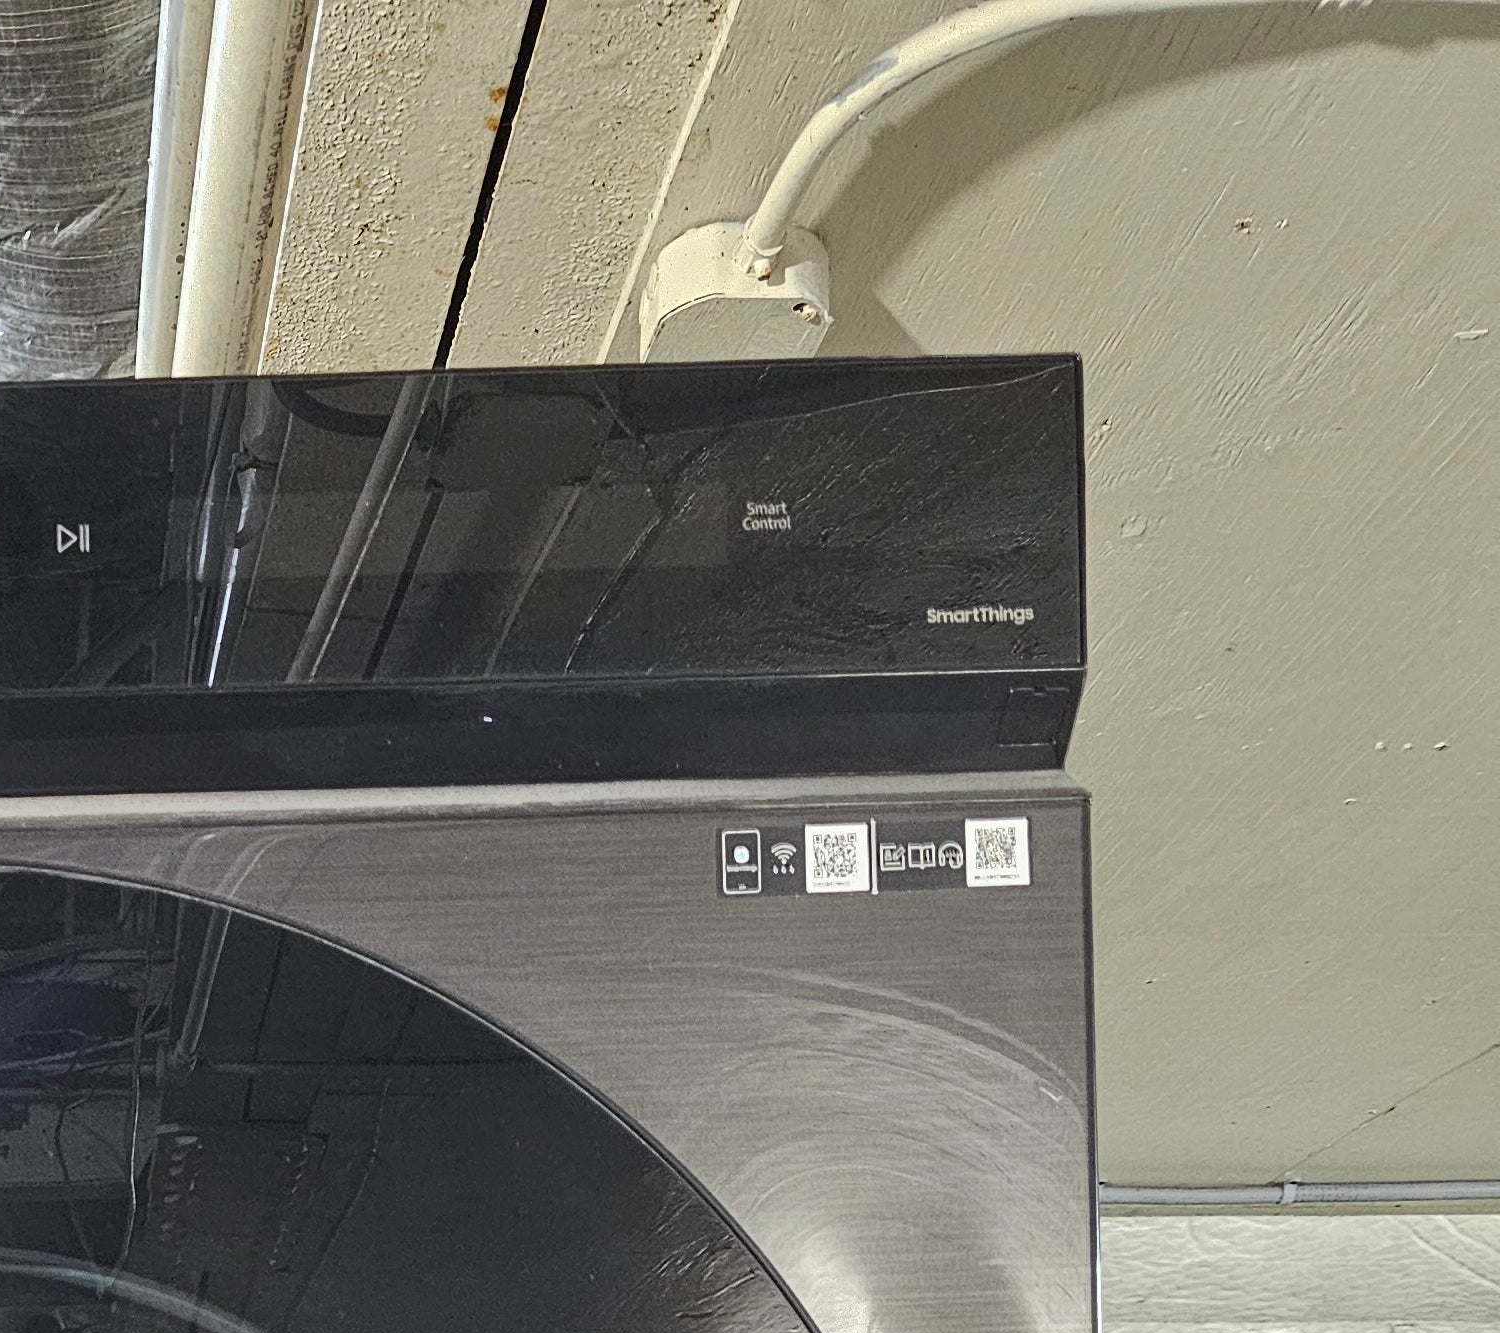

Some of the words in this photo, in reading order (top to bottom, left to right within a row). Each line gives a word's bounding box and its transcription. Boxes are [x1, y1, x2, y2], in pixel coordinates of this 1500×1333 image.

[268, 141, 282, 158] 40
[278, 54, 298, 100] CASING
[746, 501, 787, 516] Smart
[742, 515, 791, 531] Control
[926, 604, 1034, 625] SmartThings
